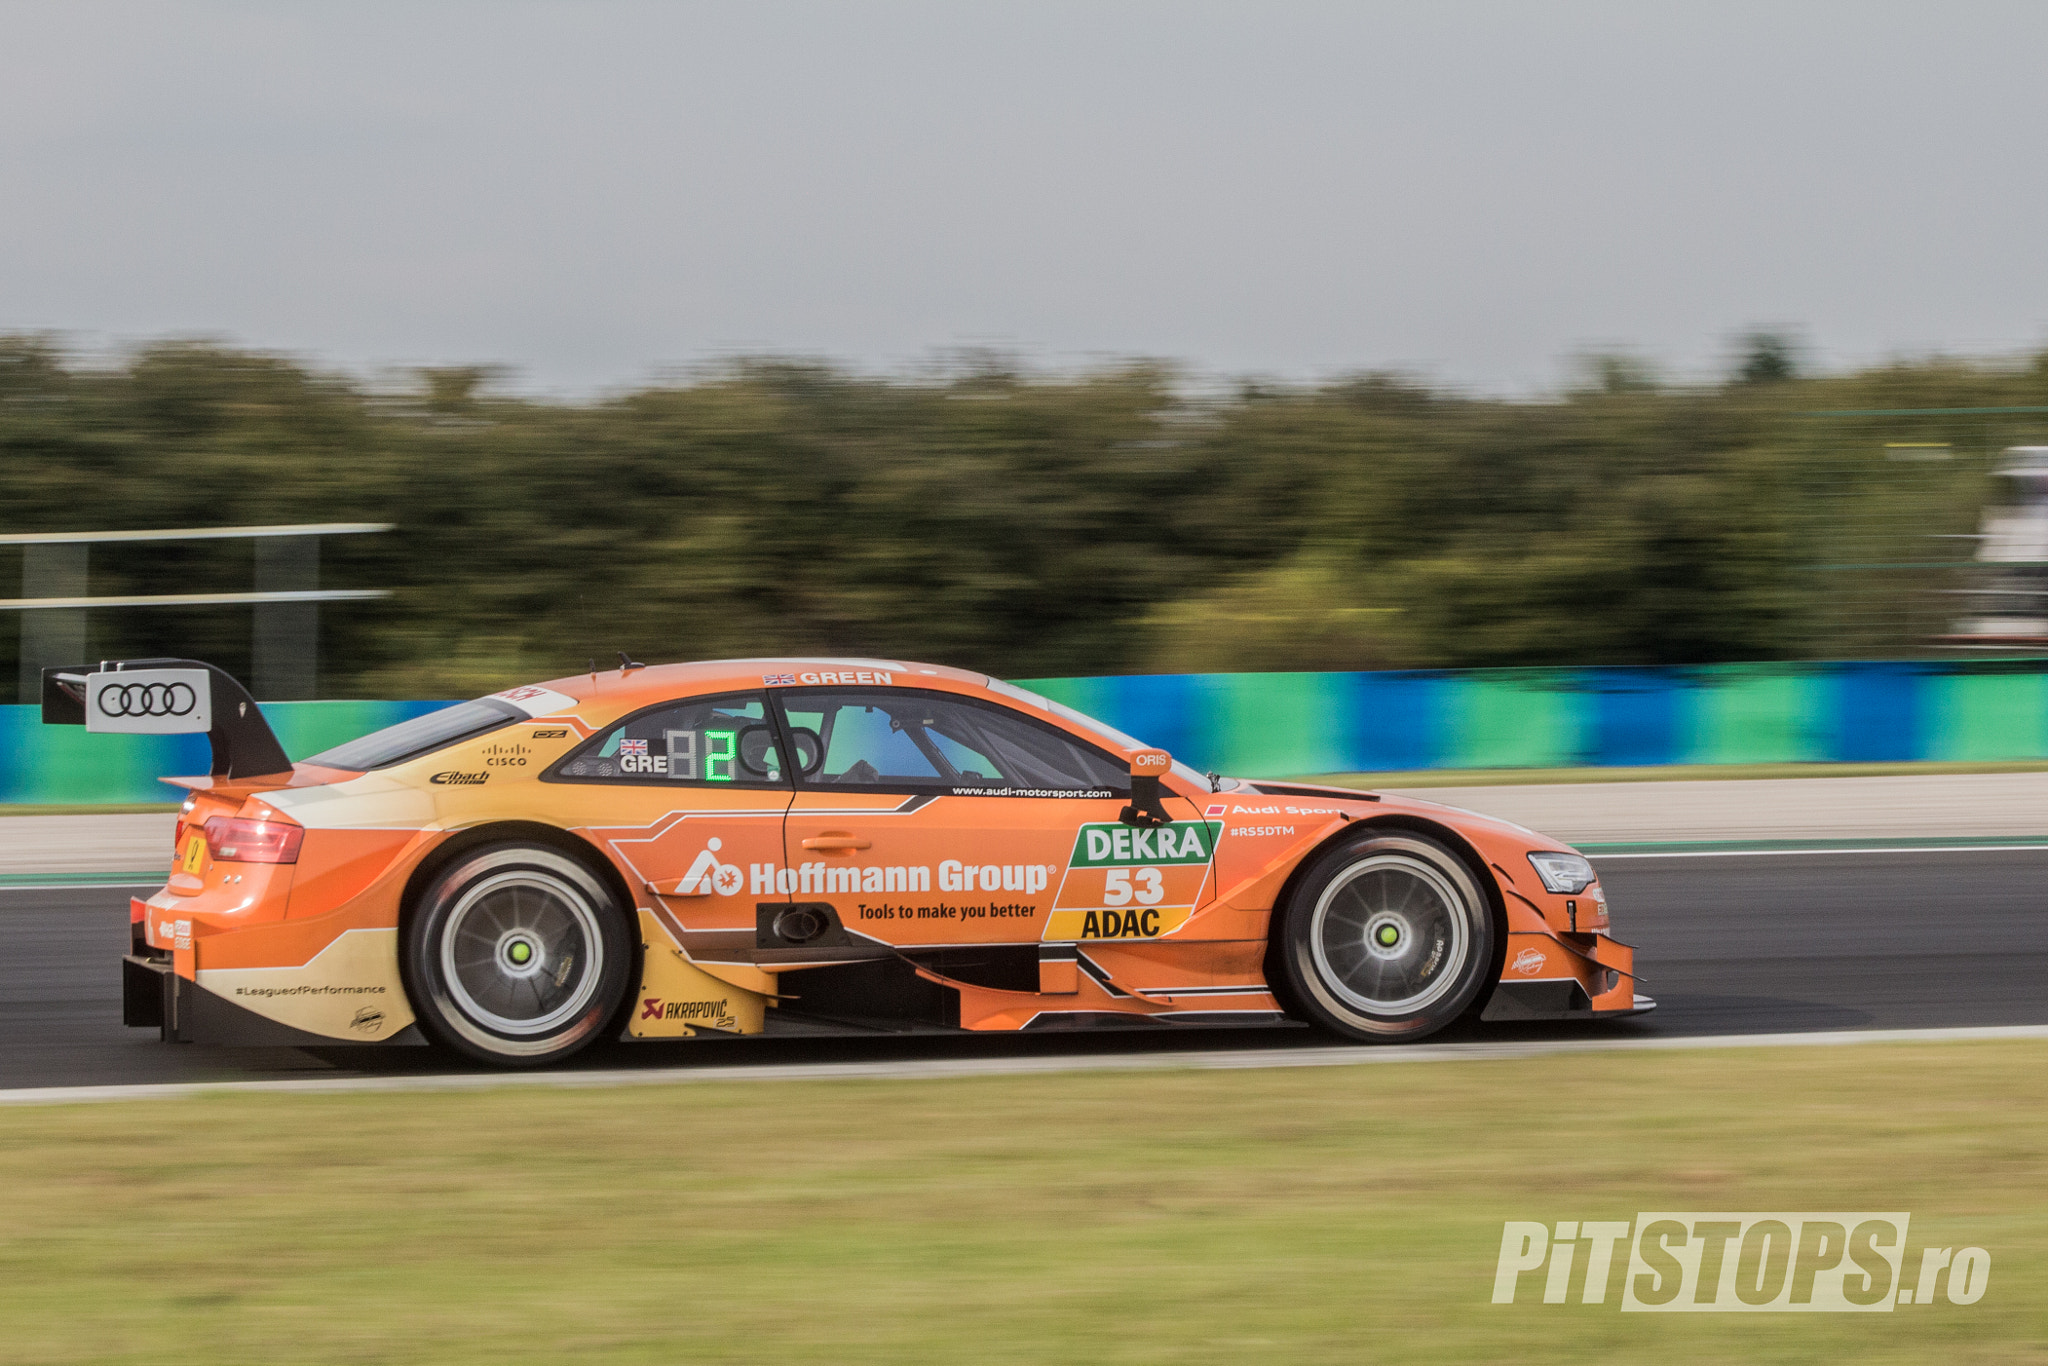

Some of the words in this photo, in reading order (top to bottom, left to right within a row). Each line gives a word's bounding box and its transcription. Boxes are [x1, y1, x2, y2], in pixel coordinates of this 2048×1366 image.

[800, 671, 893, 685] GREEN
[486, 757, 527, 766] CISCO
[704, 730, 736, 781] 2
[1136, 754, 1167, 766] ORIS
[620, 755, 668, 773] GRE
[430, 771, 490, 784] Eibach
[952, 787, 1112, 799] www.audi-motorsport.com
[1232, 805, 1281, 815] Audi
[1230, 825, 1295, 837] #RS5DTM
[1086, 826, 1206, 861] DEKRA
[749, 862, 931, 895] Hoffmann
[1103, 867, 1165, 906] 53
[858, 904, 895, 919] Tools
[898, 904, 914, 919] to
[917, 903, 957, 919] make
[960, 906, 986, 922] you
[990, 902, 1036, 918] better
[1081, 909, 1160, 938] ADAC
[236, 985, 386, 998] #LeagueofPerformance
